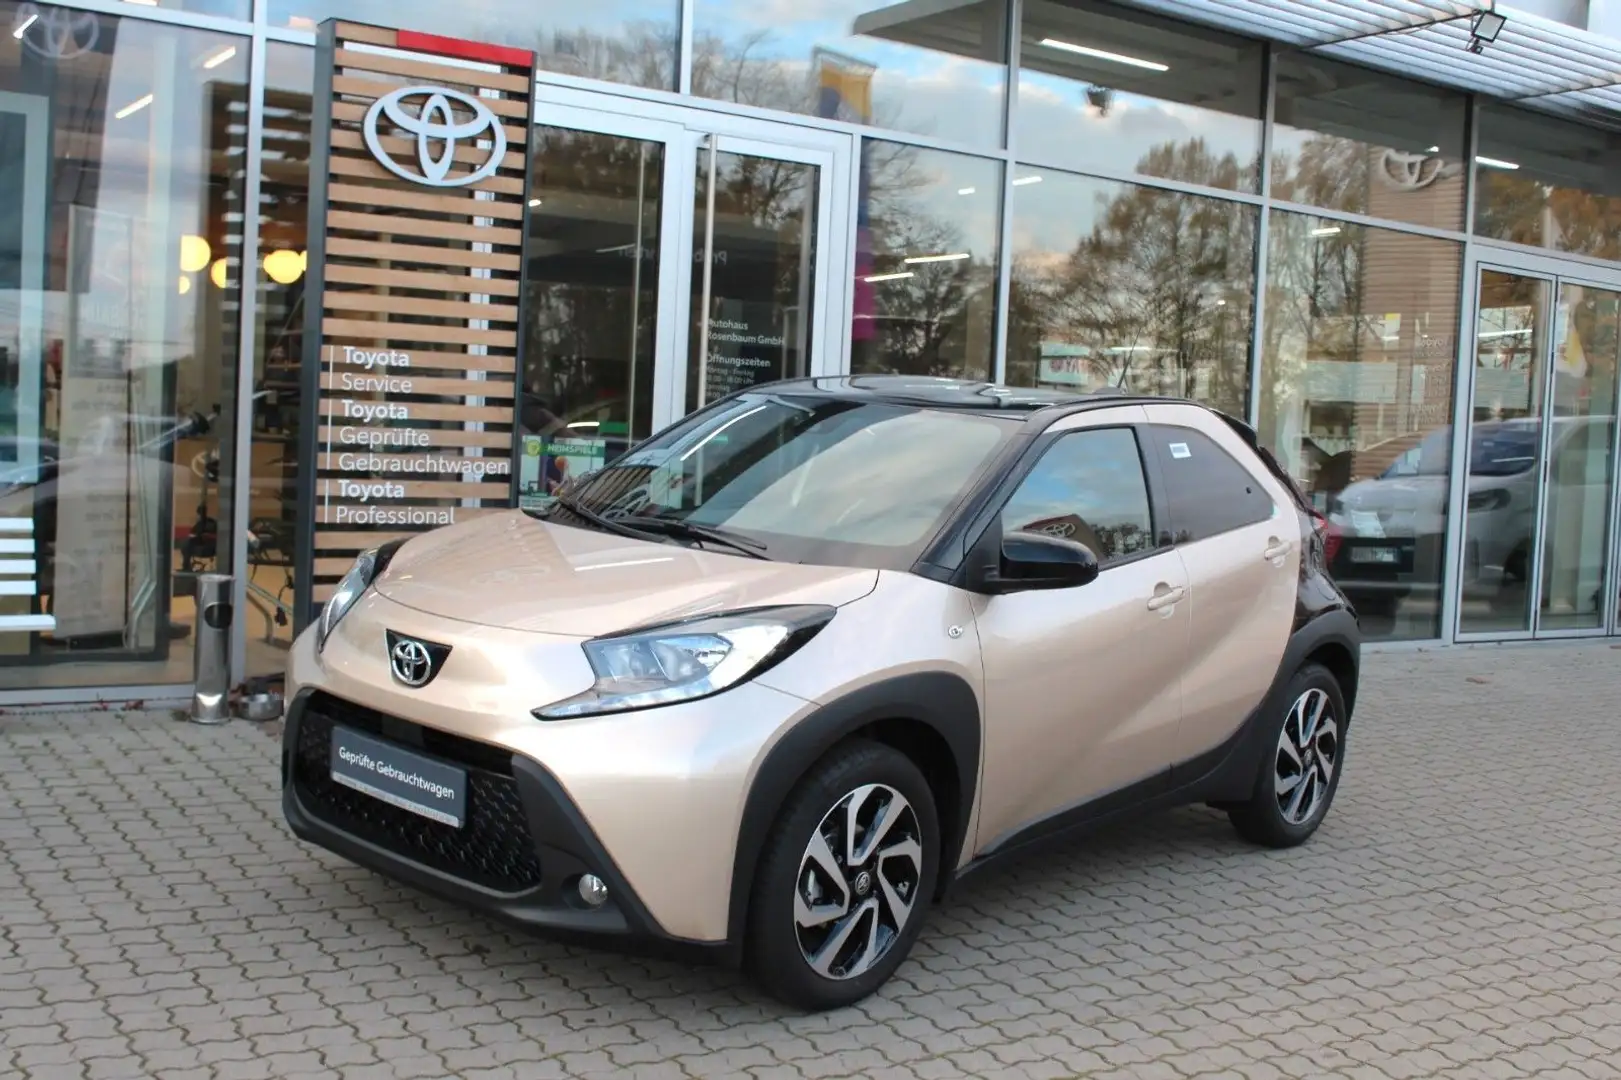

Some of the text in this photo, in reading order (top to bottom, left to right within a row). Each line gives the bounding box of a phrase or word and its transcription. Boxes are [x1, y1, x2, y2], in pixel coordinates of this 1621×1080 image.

[757, 335, 785, 345] GmbH
[343, 346, 410, 369] Toyota
[341, 374, 412, 394] Service
[341, 400, 408, 423] Toyota
[339, 426, 430, 448] Geprüfte
[338, 453, 509, 478] Gebrauchtwagen
[338, 480, 405, 501] Toyota
[336, 506, 455, 525] Professional
[338, 746, 455, 800] Geprüfte Gebrauchtwagen
